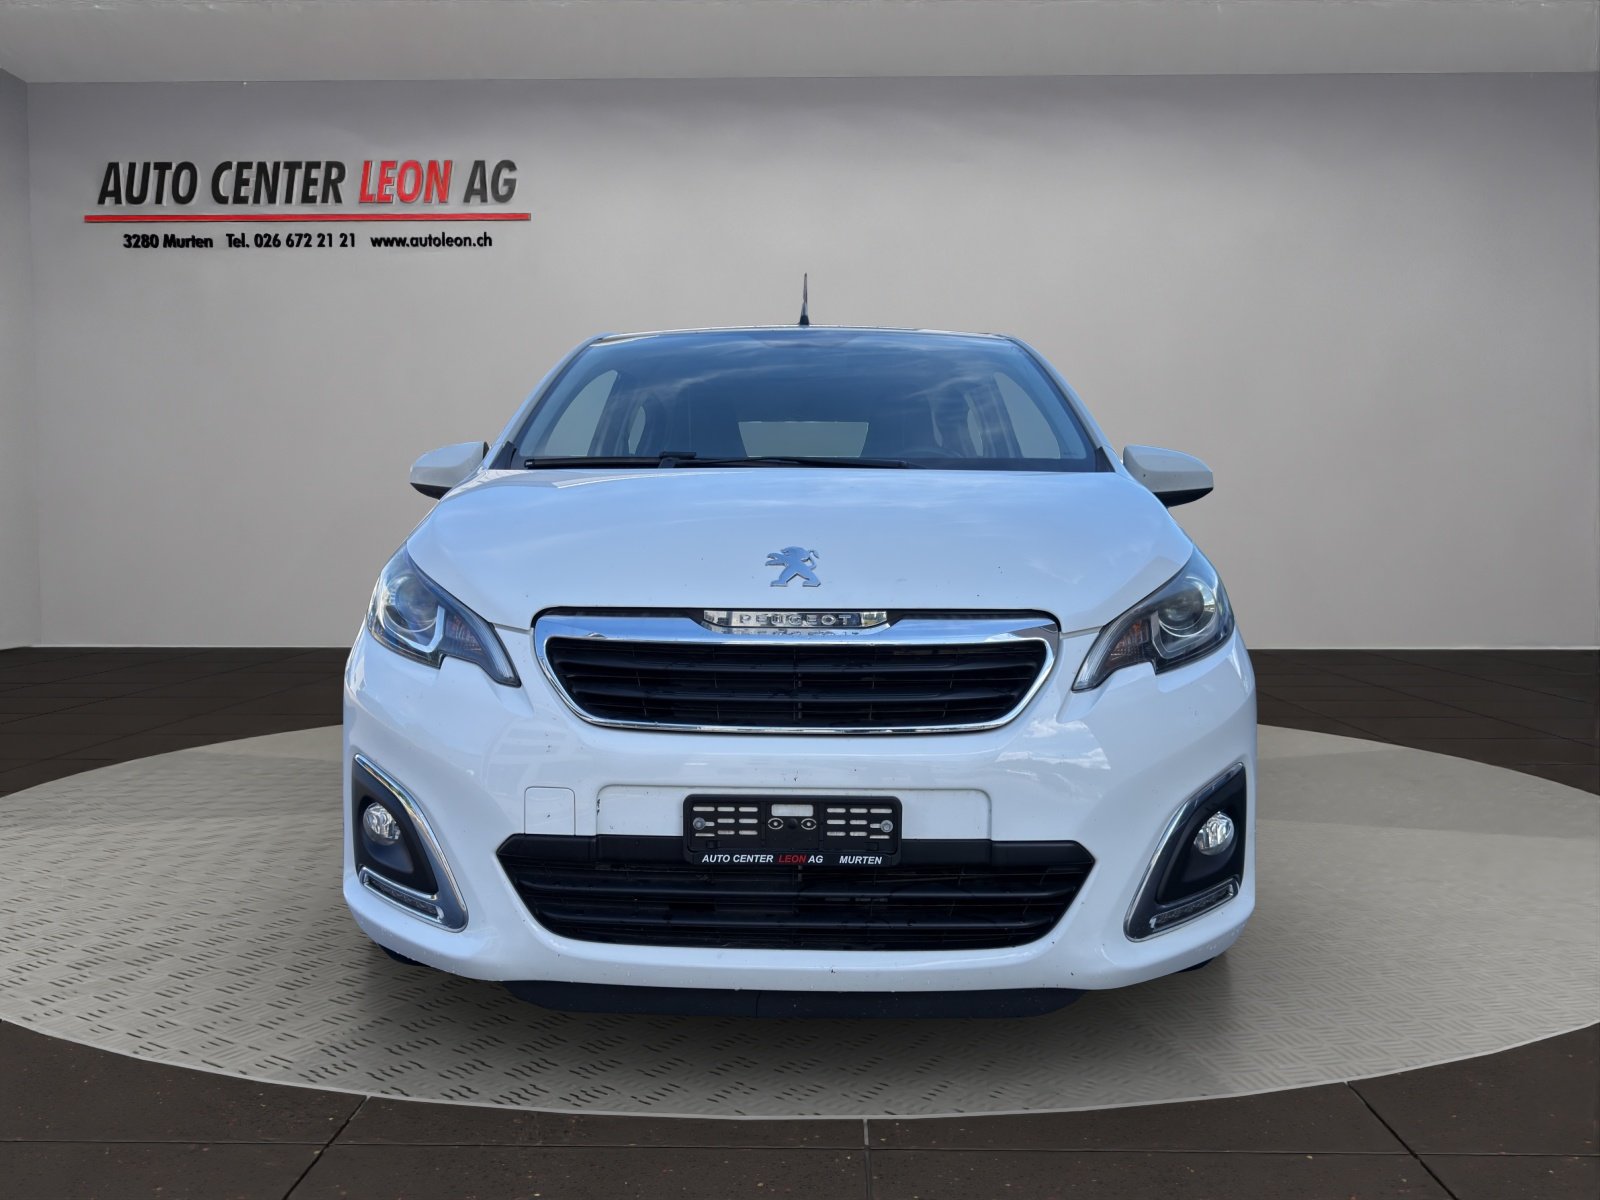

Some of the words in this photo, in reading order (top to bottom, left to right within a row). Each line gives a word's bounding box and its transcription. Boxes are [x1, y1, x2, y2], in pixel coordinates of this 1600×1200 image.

[98, 161, 198, 205] AUTO
[211, 160, 346, 205] CENTER
[358, 159, 453, 203] LEON
[464, 159, 518, 203] AG
[123, 233, 160, 249] 3280
[163, 233, 214, 249] Murten
[226, 233, 250, 248] Tel.
[254, 233, 282, 248] 026
[286, 233, 313, 248] 672
[317, 233, 335, 248] 21
[338, 233, 356, 248] 21
[370, 232, 493, 248] www.autoleon.ch
[739, 614, 852, 625] PEUGEOT
[702, 854, 731, 863] AUTO
[733, 854, 774, 863] CENTER
[779, 855, 807, 863] LEON
[808, 855, 824, 864] AG
[839, 855, 883, 865] MURTEN
